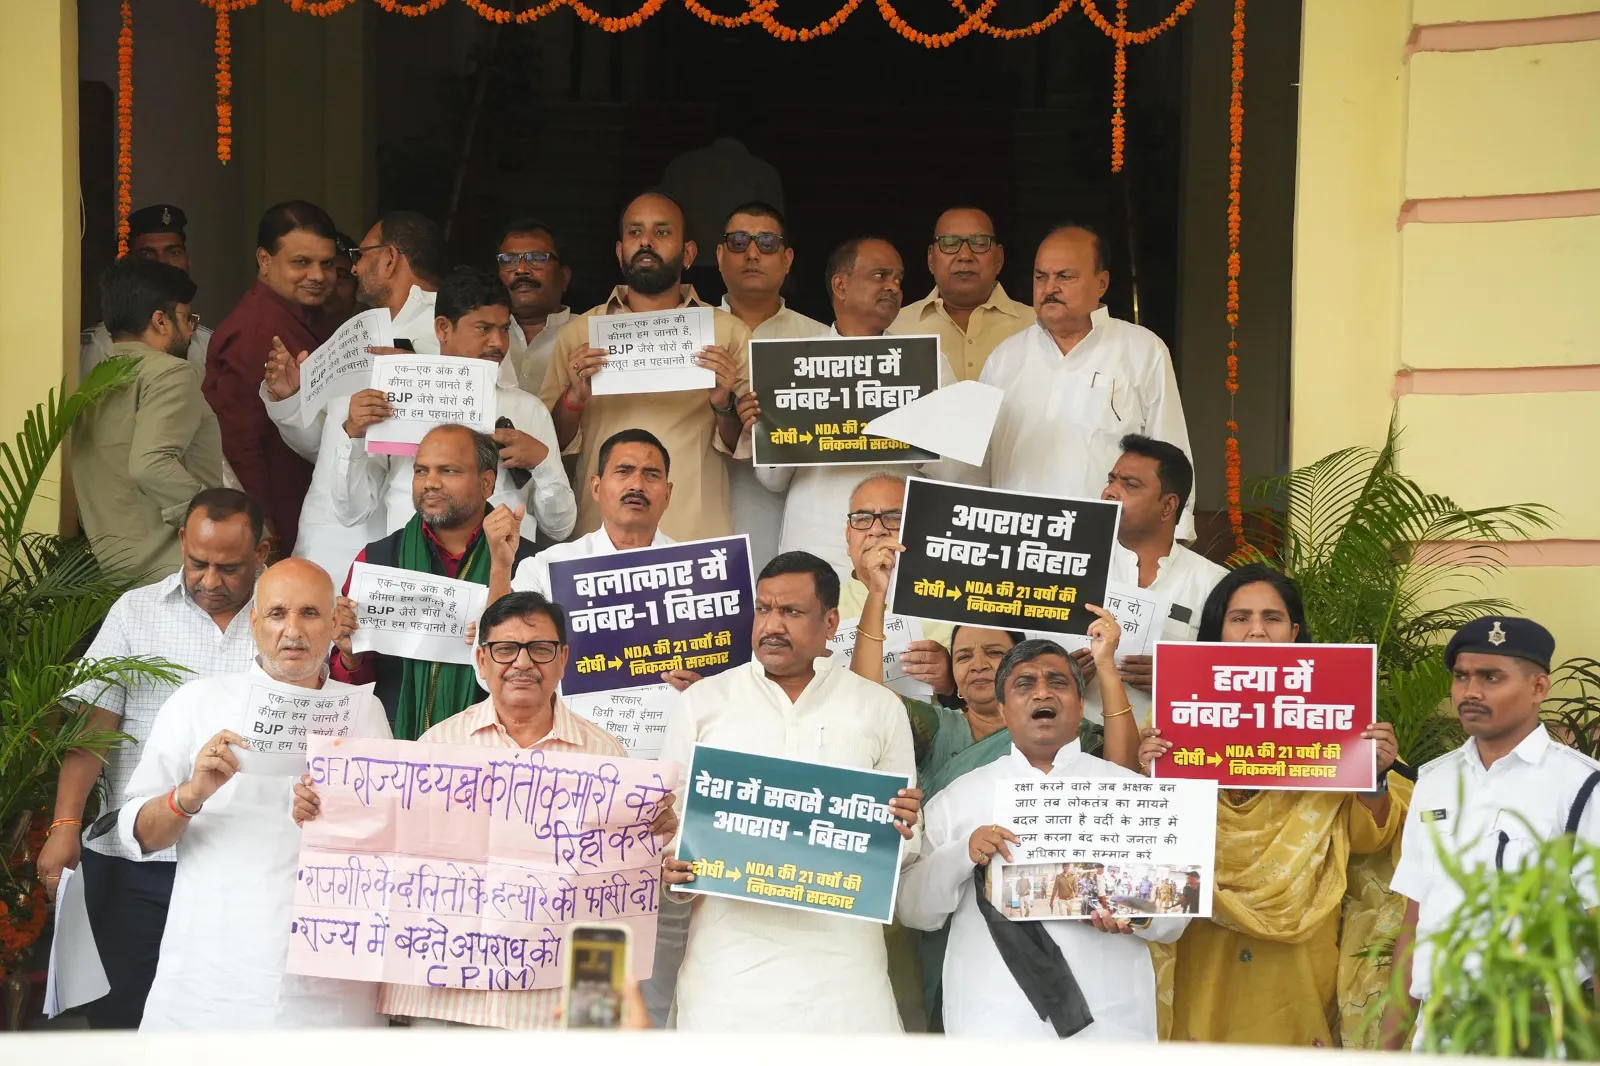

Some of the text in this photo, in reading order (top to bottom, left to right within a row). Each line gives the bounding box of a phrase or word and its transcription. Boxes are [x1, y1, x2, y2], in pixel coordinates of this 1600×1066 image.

[653, 315, 685, 325] अंक की
[637, 330, 649, 338] हम
[654, 328, 678, 337] जानते
[609, 340, 693, 355] BJP जैसे चोरों की
[633, 354, 685, 367] हम पहचानते
[793, 348, 902, 379] अपराध में
[436, 365, 452, 375] अंक
[388, 378, 461, 391] कीमत हम जानते
[387, 392, 474, 407] BJP जैसे चोरों की
[774, 380, 921, 411] नंबर-1 बिहार
[411, 409, 464, 421] हम पहचानते
[815, 423, 840, 435] NDA
[842, 420, 858, 435] की
[770, 429, 798, 445] दोषी
[818, 437, 867, 452] निकम्मी
[952, 504, 1077, 541] अपराध में
[925, 531, 1091, 577] नंबर-1 बिहार
[573, 548, 728, 597] बलात्कार में
[369, 590, 394, 602] कीमत
[420, 583, 456, 598] अंक की
[913, 578, 945, 599] दोषी
[965, 580, 1077, 604] NDA की 21 वर्षों की
[367, 605, 416, 617] BJP जैसे
[569, 588, 741, 633] नंबर-1 बिहार
[966, 596, 1070, 621] निकम्मी सरकार
[359, 617, 446, 633] करतूत हम पहचानते
[1123, 619, 1139, 634] को
[624, 631, 731, 659] NDA की 21 वर्षों की
[575, 654, 606, 674] दोषी
[629, 651, 729, 676] निकम्मी सरकार
[1212, 659, 1315, 693] हत्या में
[315, 695, 349, 709] अंक की
[258, 706, 339, 723] कीमत हम जानते
[619, 709, 635, 719] नहीं
[1170, 693, 1355, 730] नंबर-1 बिहार
[254, 721, 306, 736] BJP जैसे
[606, 721, 628, 733] शिक्षा
[278, 741, 292, 750] हम
[1225, 742, 1342, 760] NDA की 21 वर्षों की
[1173, 748, 1205, 766] दोषी
[1229, 760, 1337, 778] निकम्मी सरकार
[1014, 781, 1176, 793] रक्षा करने वाले जब भक्षक बन
[695, 770, 895, 825] देश में सबसे अधिक
[1015, 795, 1169, 809] जाए तब लोकतंत्र का मायने
[1012, 813, 1179, 829] बदल जाता है वर्दी के आड़ में
[713, 810, 871, 854] अपराध बिहार
[1044, 833, 1072, 843] करना
[1078, 830, 1094, 843] बंद
[1100, 833, 1119, 843] करो
[1126, 835, 1158, 845] जनता
[1164, 834, 1178, 845] की
[552, 820, 605, 876] रिहा
[1026, 847, 1152, 860] अधिकार का सम्मान करें
[692, 858, 725, 879] दोषी
[745, 862, 862, 892] NDA की 21 वर्षों की
[552, 877, 577, 921] को
[746, 877, 855, 910] निकम्मी सरकार
[297, 917, 360, 955] राज्य
[367, 912, 390, 957] में
[529, 927, 562, 968] को
